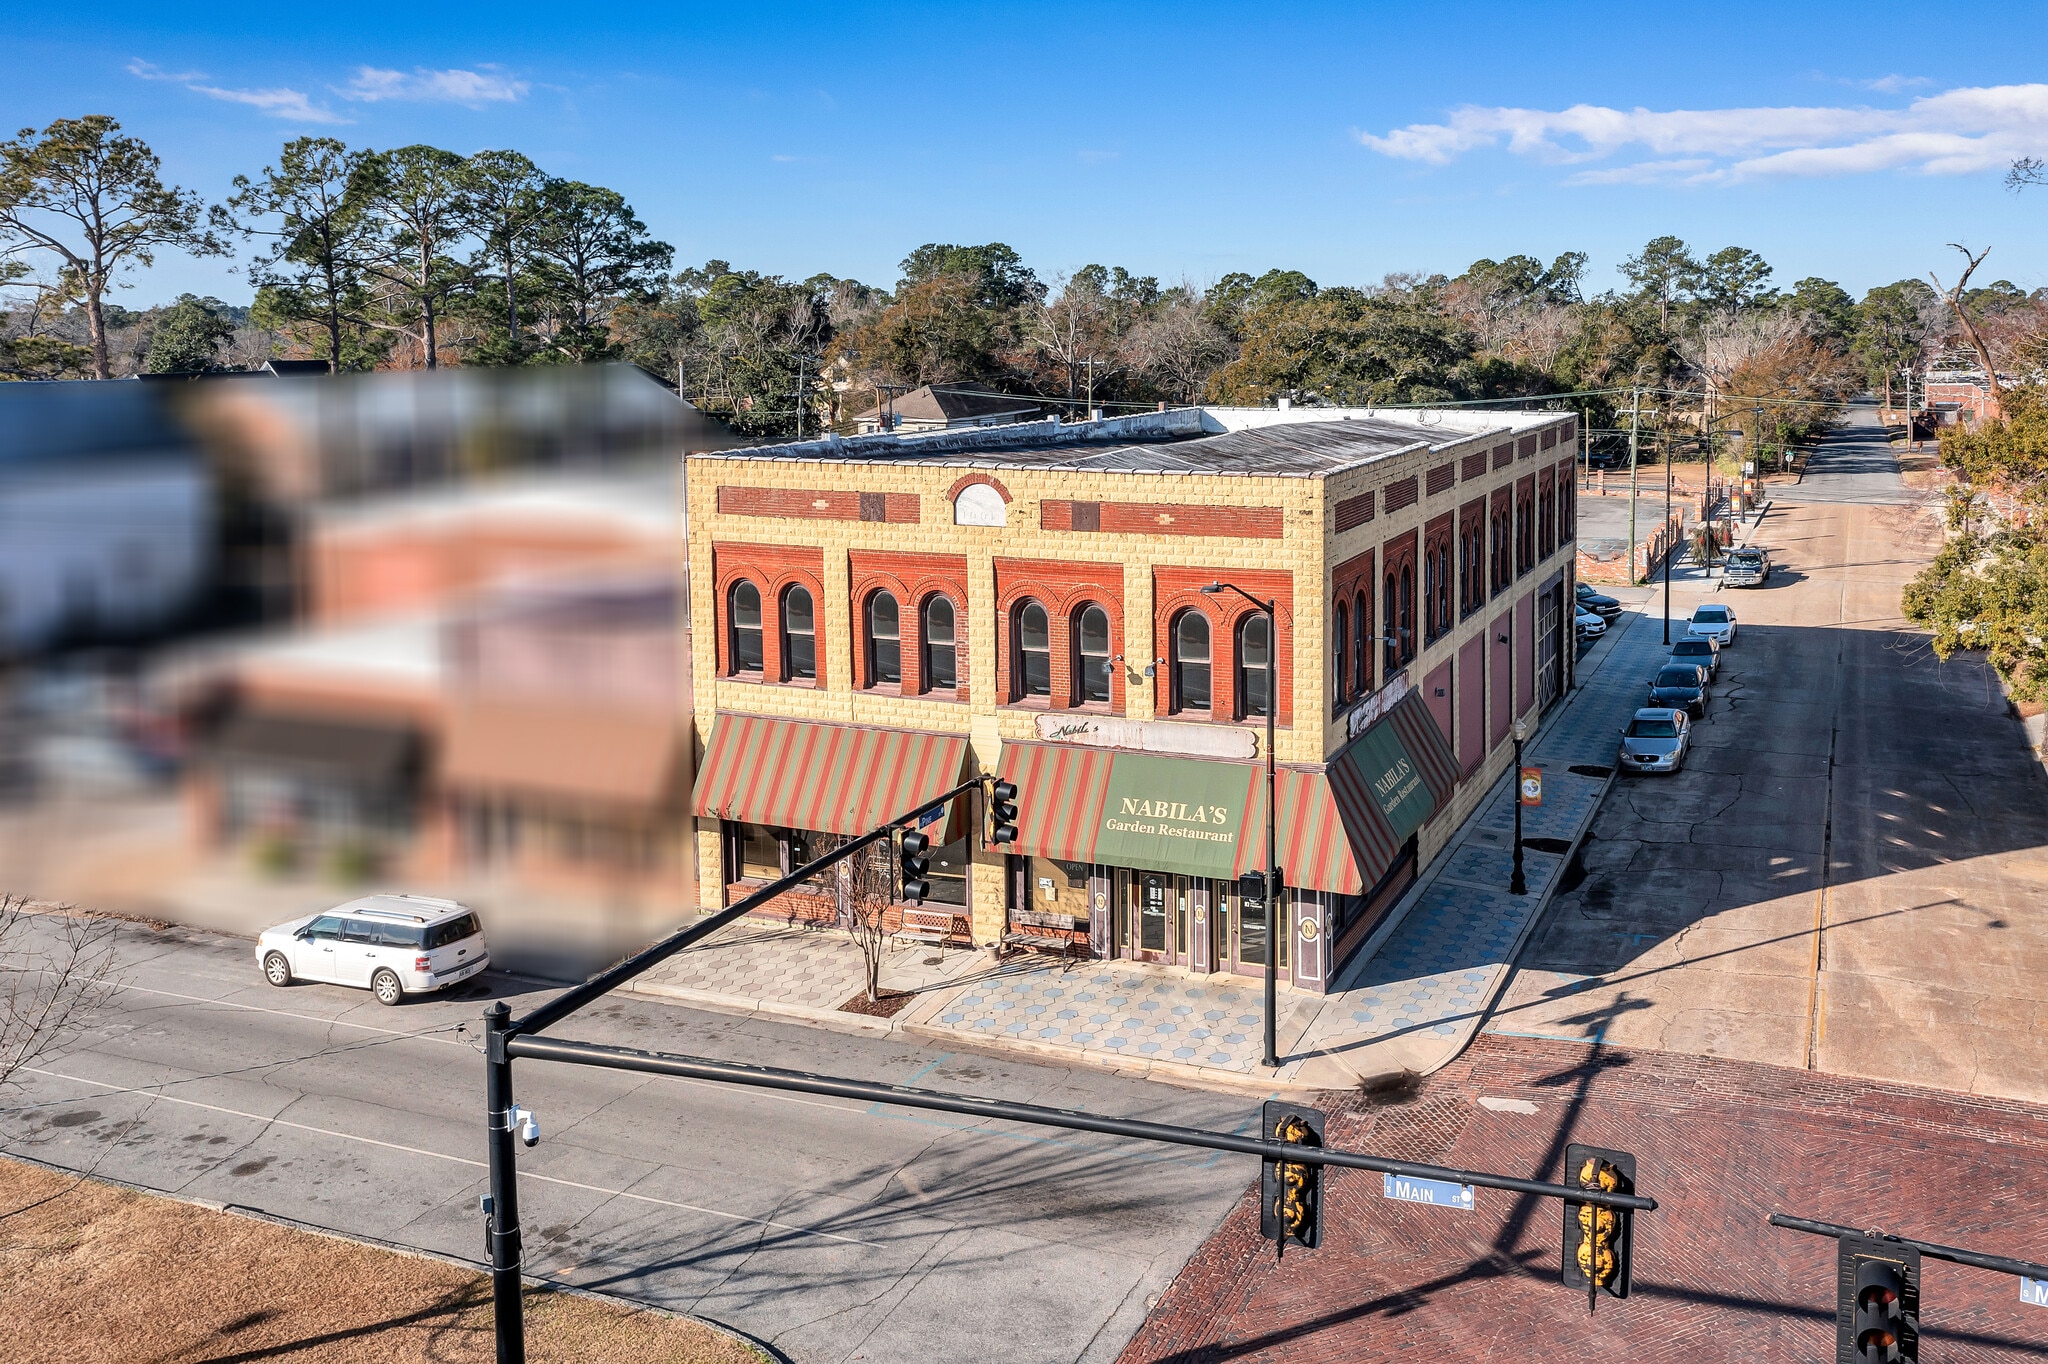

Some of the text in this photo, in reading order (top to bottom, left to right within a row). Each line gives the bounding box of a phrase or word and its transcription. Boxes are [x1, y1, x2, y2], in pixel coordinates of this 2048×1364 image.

[1375, 758, 1410, 797] NABILA'S
[1120, 797, 1228, 825] NABILA'S
[1383, 796, 1401, 815] Garden
[1106, 818, 1234, 843] Garden Restaurant
[1066, 863, 1085, 872] OPEN
[1304, 924, 1313, 935] N
[1386, 1185, 1391, 1193] S
[1451, 1194, 1461, 1204] ST
[2023, 1290, 2029, 1298] S
